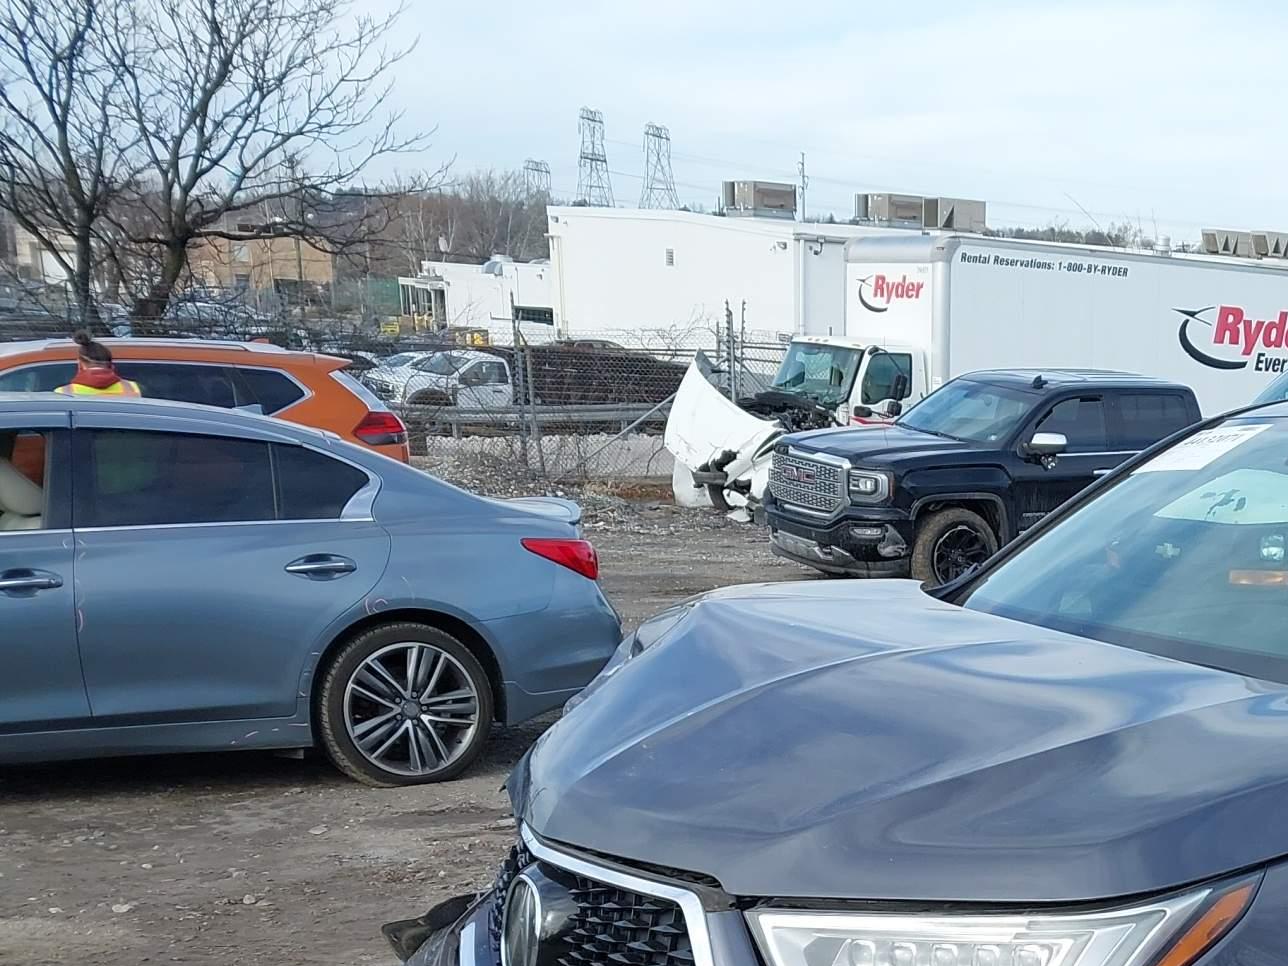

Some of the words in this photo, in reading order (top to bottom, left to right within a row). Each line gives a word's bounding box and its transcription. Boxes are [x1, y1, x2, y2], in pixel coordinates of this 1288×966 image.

[961, 252, 990, 265] Rental
[993, 255, 1055, 271] Reservations:
[1058, 261, 1129, 278] 1-800-BY-RYDER
[873, 274, 924, 304] Ryder
[1254, 352, 1287, 374] Ever
